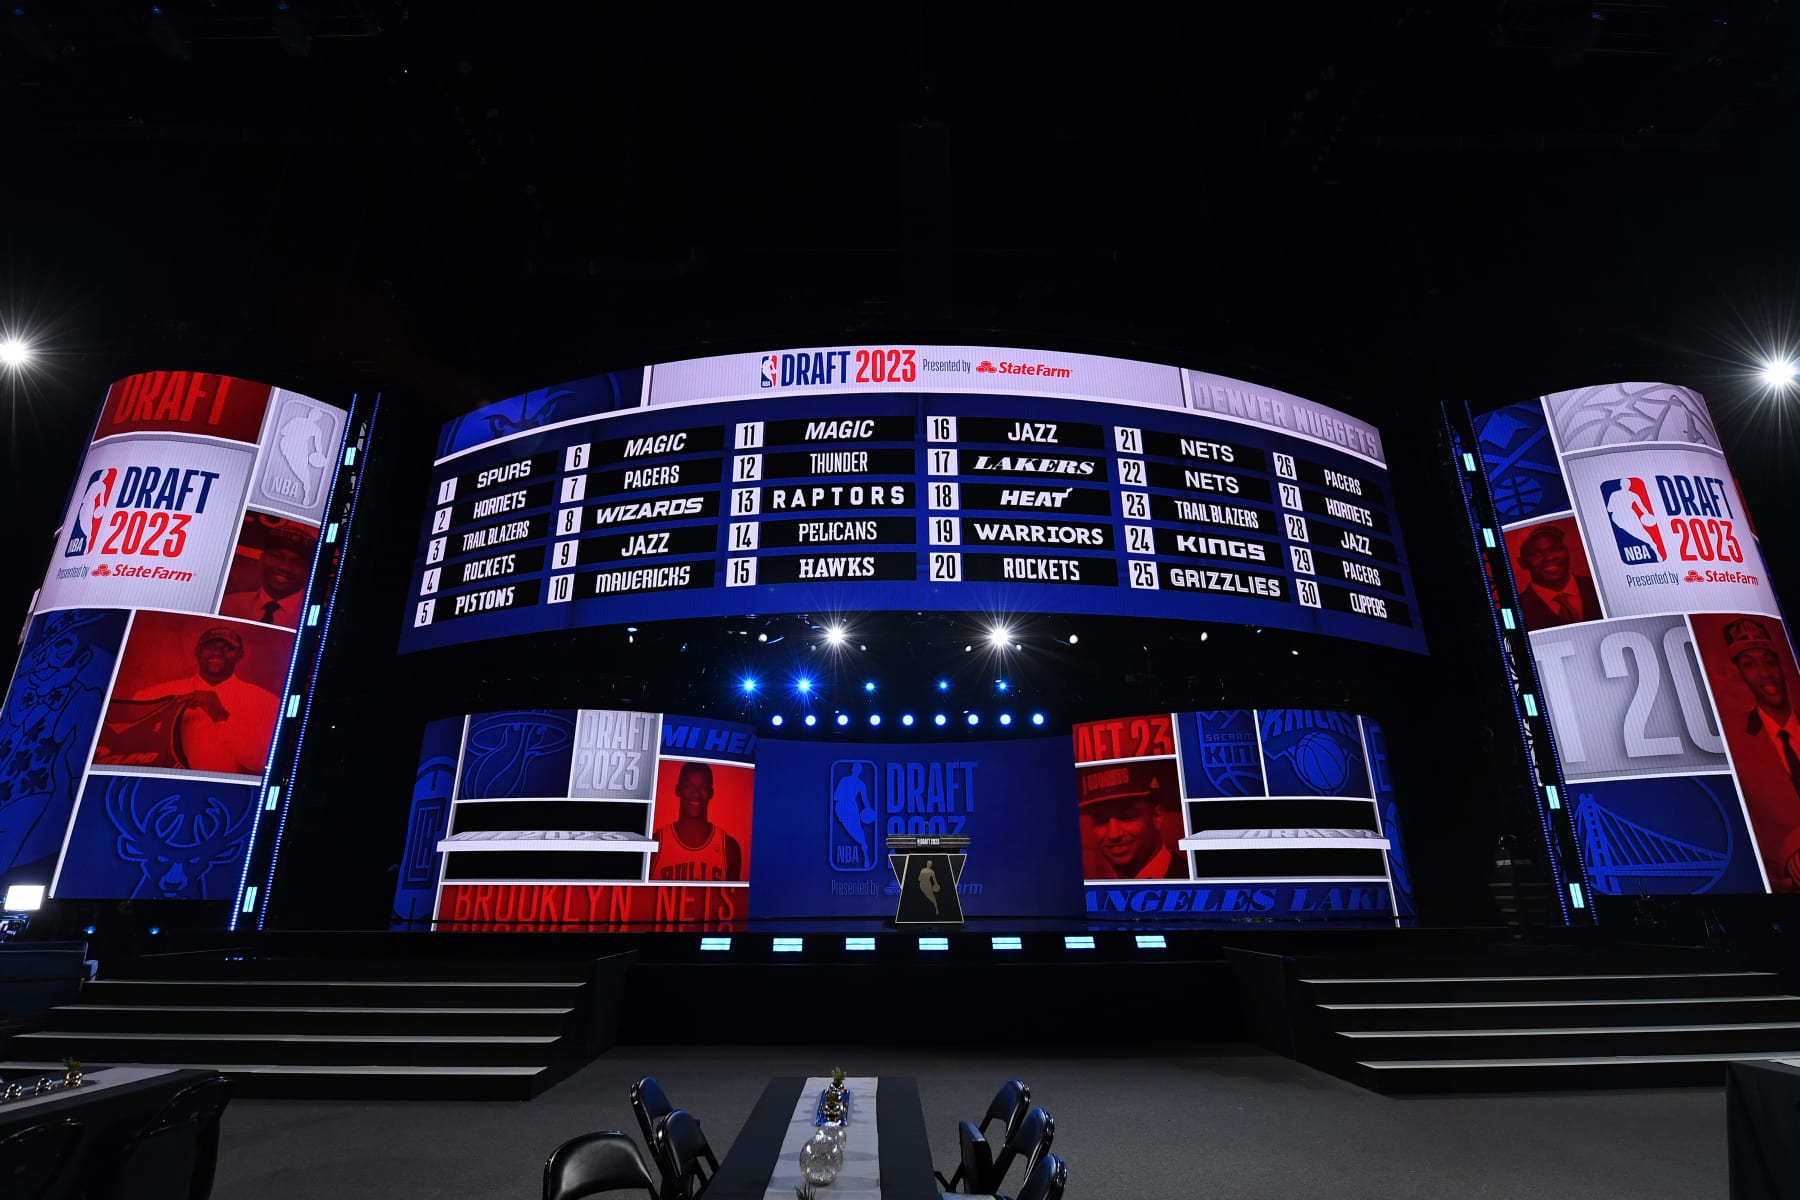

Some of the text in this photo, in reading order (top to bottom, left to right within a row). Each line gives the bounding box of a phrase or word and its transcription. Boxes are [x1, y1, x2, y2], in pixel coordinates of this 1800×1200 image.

[781, 351, 851, 387] DRAFT
[855, 349, 916, 383] 2023
[922, 359, 961, 372] Presented
[962, 360, 971, 374] by
[743, 420, 874, 447] 11 MAGIC
[933, 418, 1058, 443] 16 JAZZ
[1194, 382, 1379, 458] DENVER NUGGETS
[573, 433, 686, 468] 6 MAGIC
[934, 450, 1094, 474] 17 LAKERS
[1120, 428, 1234, 462] 21 NETS
[444, 460, 531, 501] 1 SPURS
[570, 465, 679, 500] 7 PACERS
[739, 452, 867, 480] 12 THUNDER
[1122, 460, 1239, 493] 22 NETS
[1276, 454, 1361, 495] 26 PACERS
[116, 466, 220, 514] DRAFT
[271, 478, 300, 498] NBA
[738, 486, 904, 514] 13 RAPTORS
[934, 484, 1073, 508] 18 HEAT
[1126, 493, 1146, 518] 23
[1282, 485, 1372, 526] 27 HORNETS
[1655, 475, 1733, 519] DRAFT
[437, 490, 526, 531] 2 HORNETS
[564, 497, 704, 533] 8 WIZARDS
[101, 511, 192, 557] 2023
[735, 521, 877, 548] 14 PELICANS
[935, 519, 1103, 544] 19 WARRIORS
[1130, 527, 1265, 561] 24 KINGS
[1288, 516, 1372, 555] 28 JAZZ
[1671, 519, 1744, 563] 2023
[432, 539, 441, 561] 3
[560, 533, 669, 566] 9 JAZZ
[935, 554, 1079, 580] 20 ROCKETS
[1294, 548, 1381, 586] 29 PACERS
[1624, 545, 1651, 561] NBA
[426, 554, 515, 592] 4 ROCKETS
[553, 566, 690, 601] 10 MAVERICKS
[733, 557, 874, 584] 15 HAWKS
[1133, 562, 1280, 596] 25 GRIZZLIES
[1626, 572, 1669, 587] Presented
[1669, 571, 1679, 585] by
[420, 587, 515, 624] 5 PISTONS
[1299, 581, 1387, 618] 30 CLIPPERS
[581, 711, 656, 751] DRAFT
[576, 750, 641, 791] 2023
[886, 761, 977, 814] DRAFT
[837, 846, 859, 863] NBA
